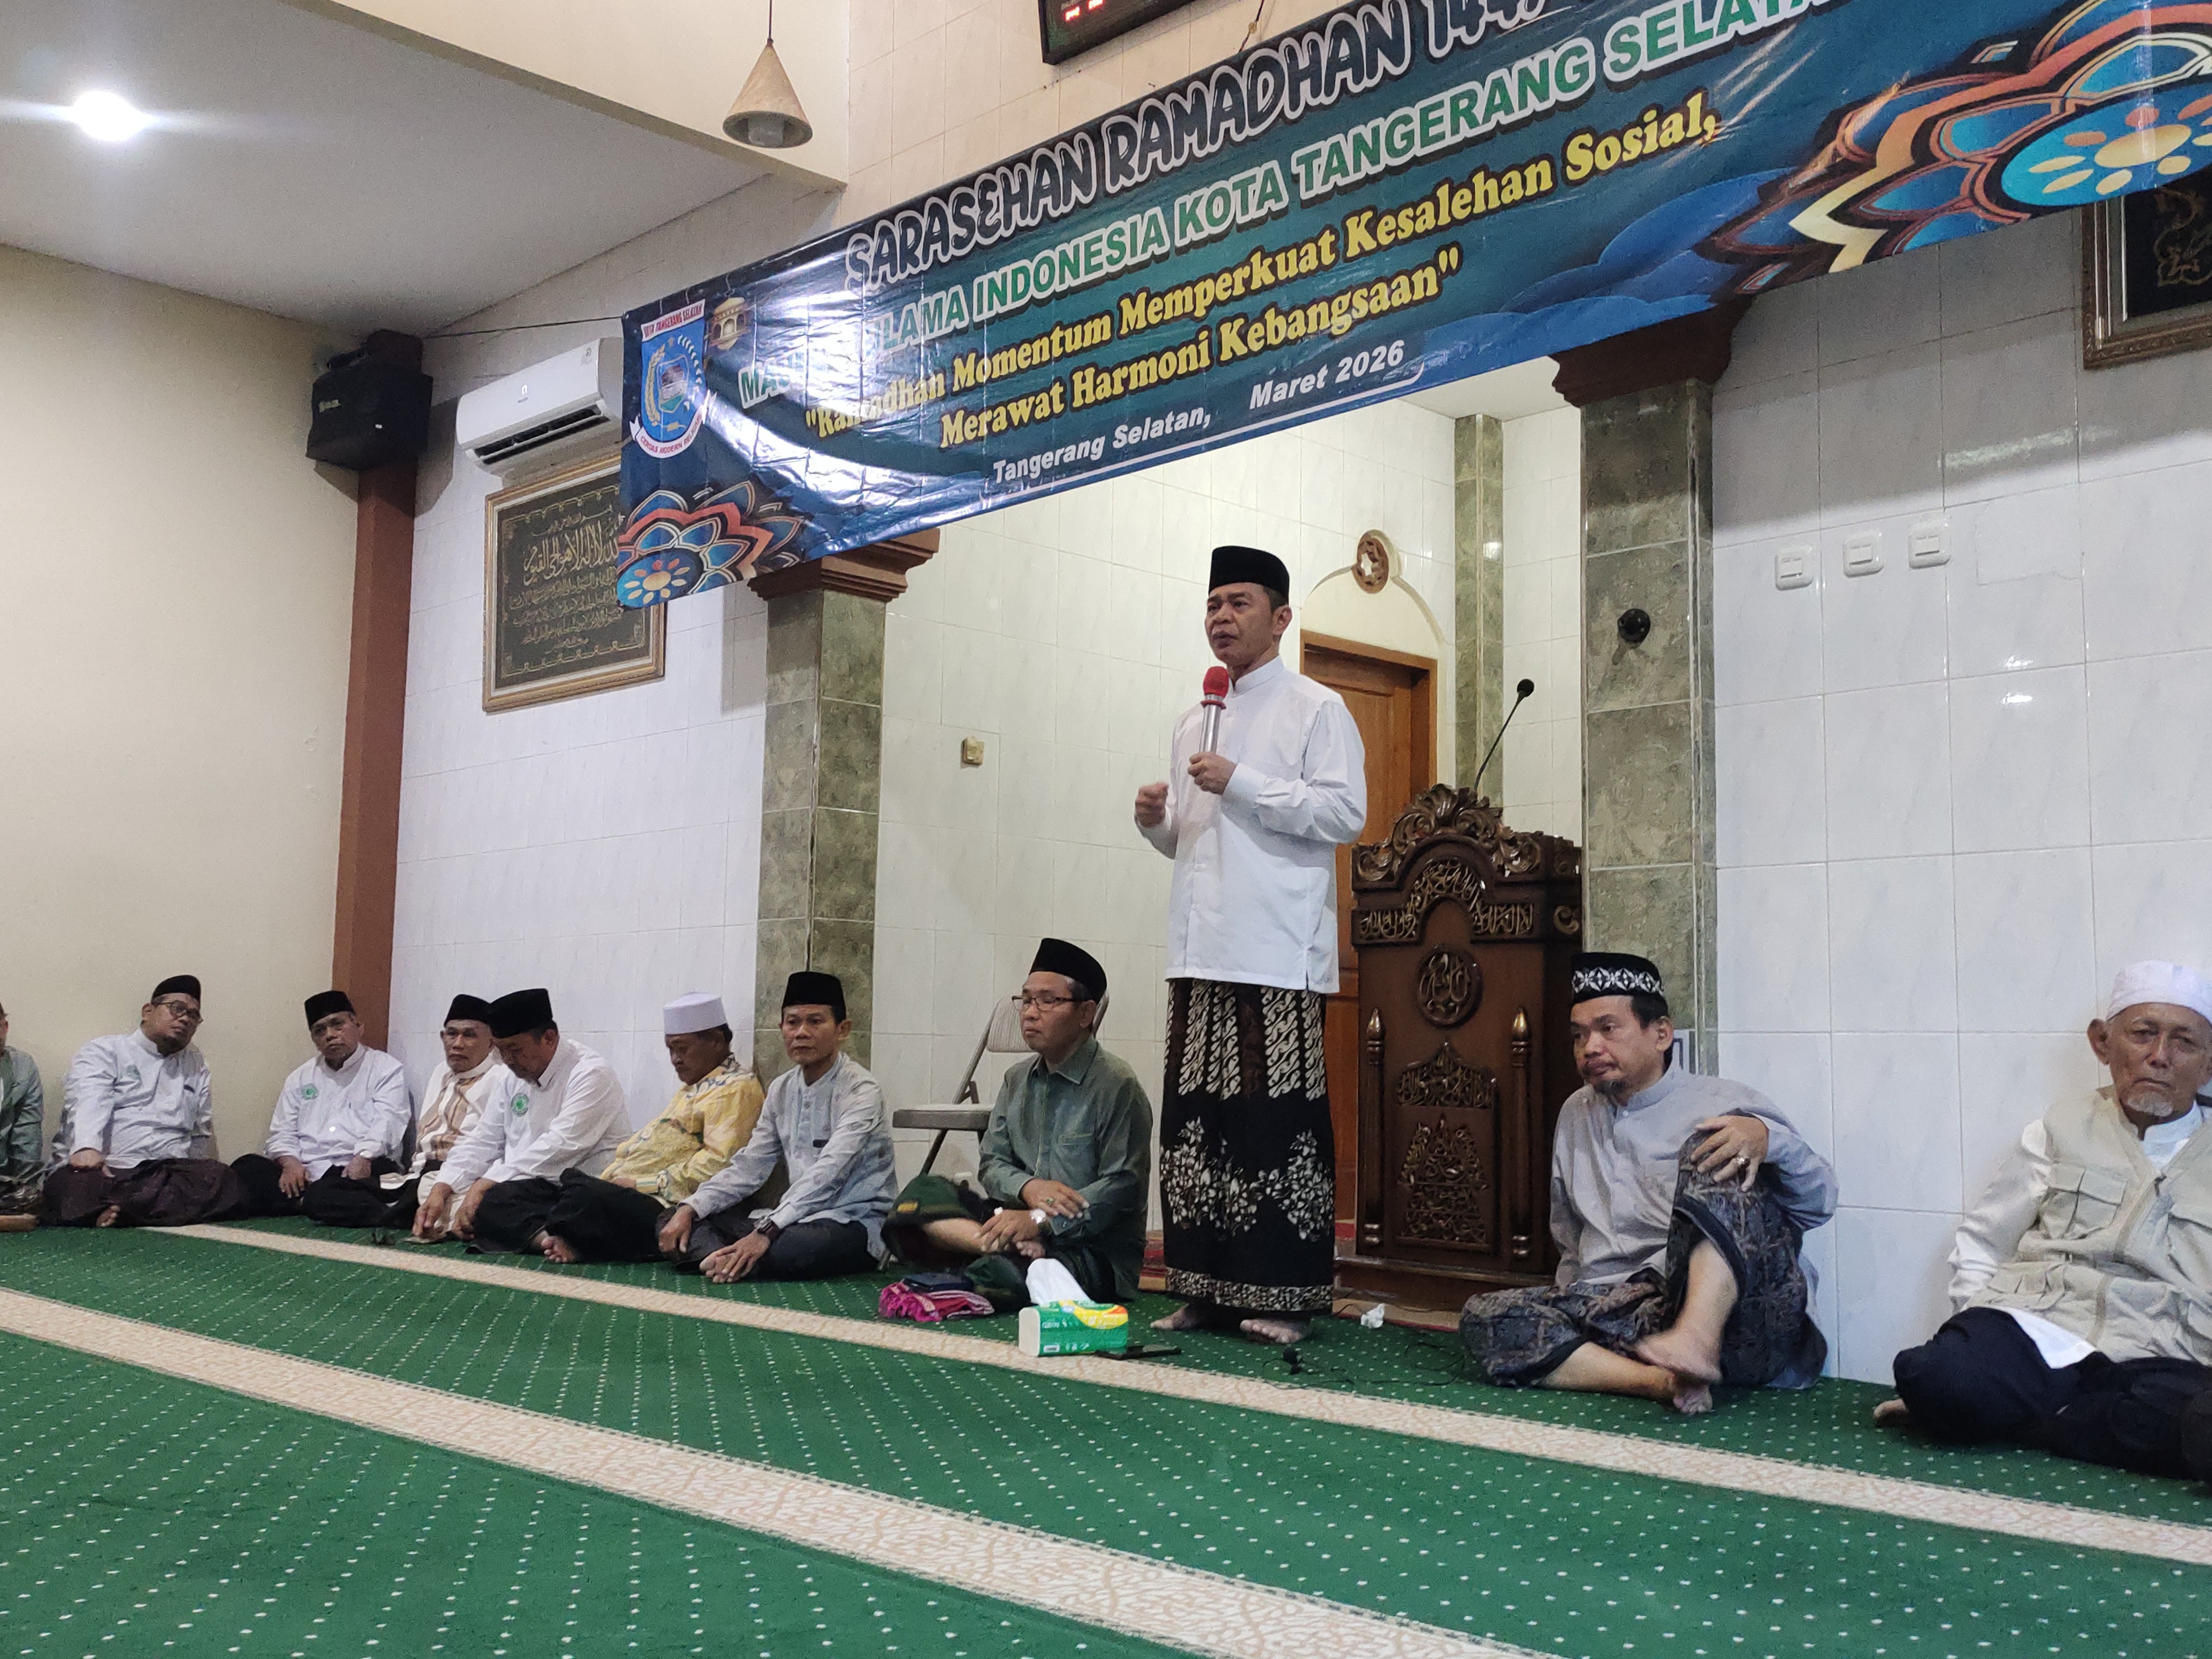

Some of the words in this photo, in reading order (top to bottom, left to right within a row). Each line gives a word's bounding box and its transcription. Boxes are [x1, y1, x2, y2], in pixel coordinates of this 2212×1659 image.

[845, 132, 1096, 290] SARASEHAN
[1101, 0, 1410, 193] RAMADHAN
[953, 314, 1111, 391] Momentum
[1120, 230, 1336, 334] Memperkuat
[1346, 160, 1553, 256] Kesalehan
[1566, 92, 1715, 180] Sosial,
[973, 207, 1170, 323] INDONESIA
[1174, 160, 1289, 247] KOTA
[1291, 37, 1595, 200] TANGERANG
[940, 383, 1064, 448] Merawat
[1073, 331, 1210, 407] Harmoni
[1219, 247, 1458, 361] Kebangsaan"
[994, 436, 1106, 484] Tangerang
[1113, 407, 1211, 448] Selatan,
[1249, 364, 1328, 410] Maret
[1335, 340, 1405, 383] 2026
